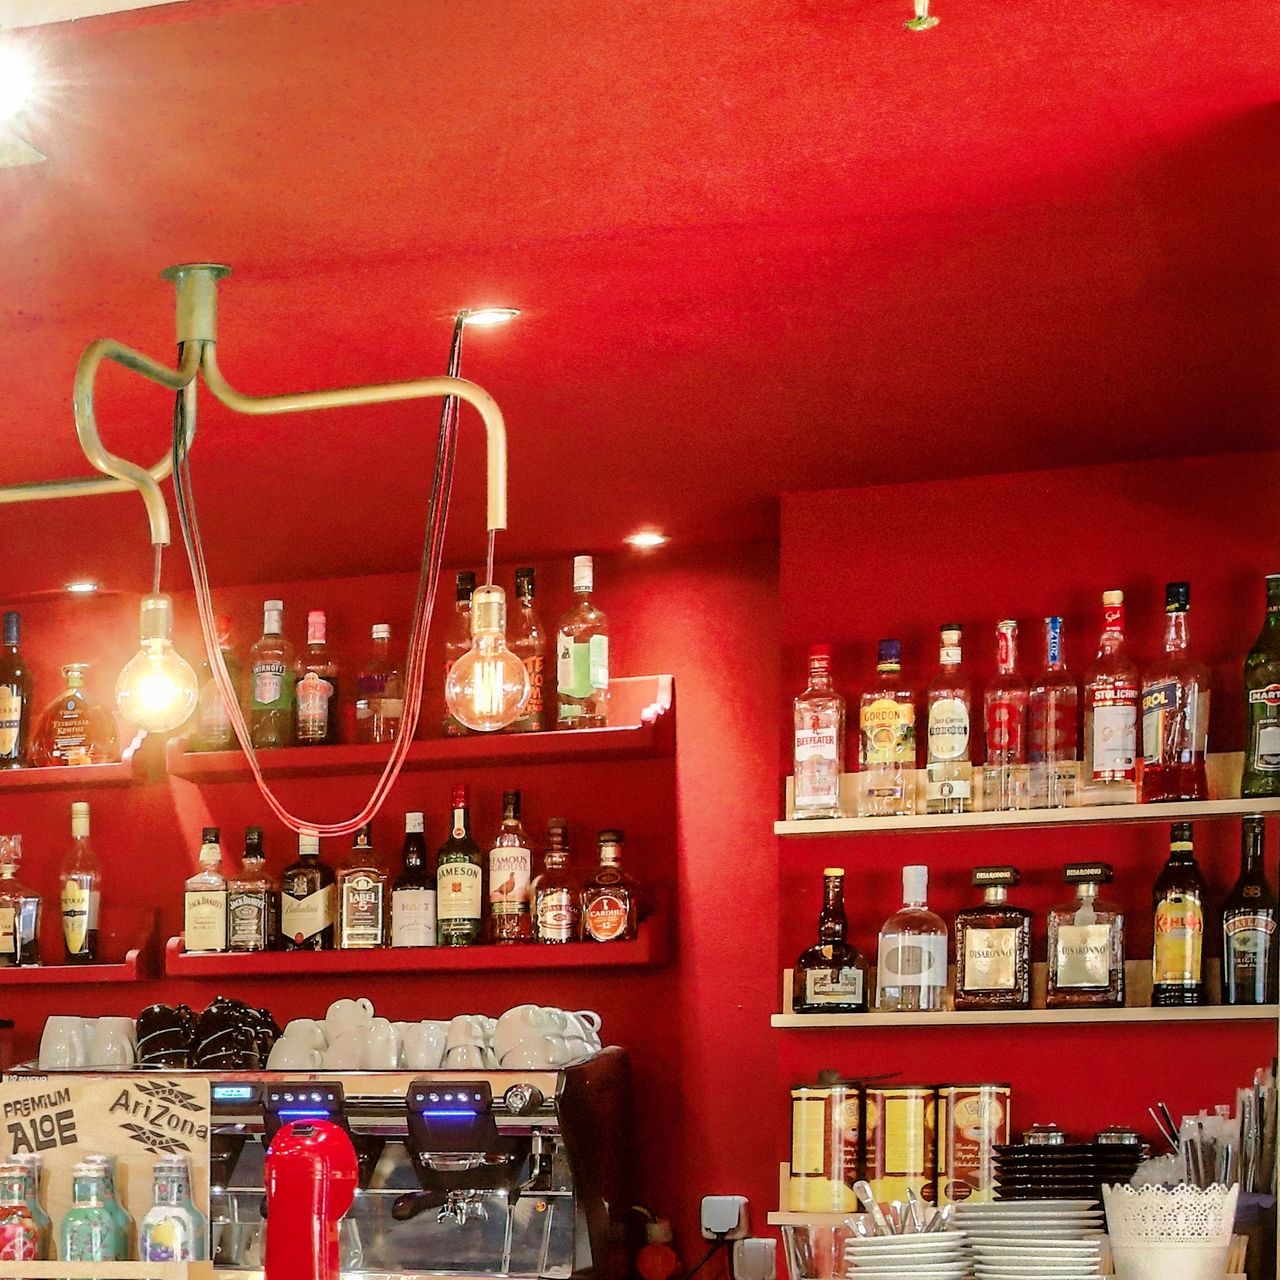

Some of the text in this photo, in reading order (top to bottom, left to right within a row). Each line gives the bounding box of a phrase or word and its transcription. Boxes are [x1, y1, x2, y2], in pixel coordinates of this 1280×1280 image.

[796, 735, 835, 747] BEEFEATER
[492, 856, 528, 864] FAMOUS
[491, 863, 528, 872] GROUSE
[1067, 868, 1102, 876] DISARONNO
[438, 866, 479, 881] JAMESON
[976, 871, 1011, 879] DISARONNO
[350, 892, 378, 904] LABEL
[589, 909, 626, 918] CARDHU
[969, 950, 1012, 959] DISARONNO
[3, 1087, 72, 1118] PREMIUM
[108, 1089, 209, 1142] AriZona
[7, 1109, 79, 1155] ALOE
